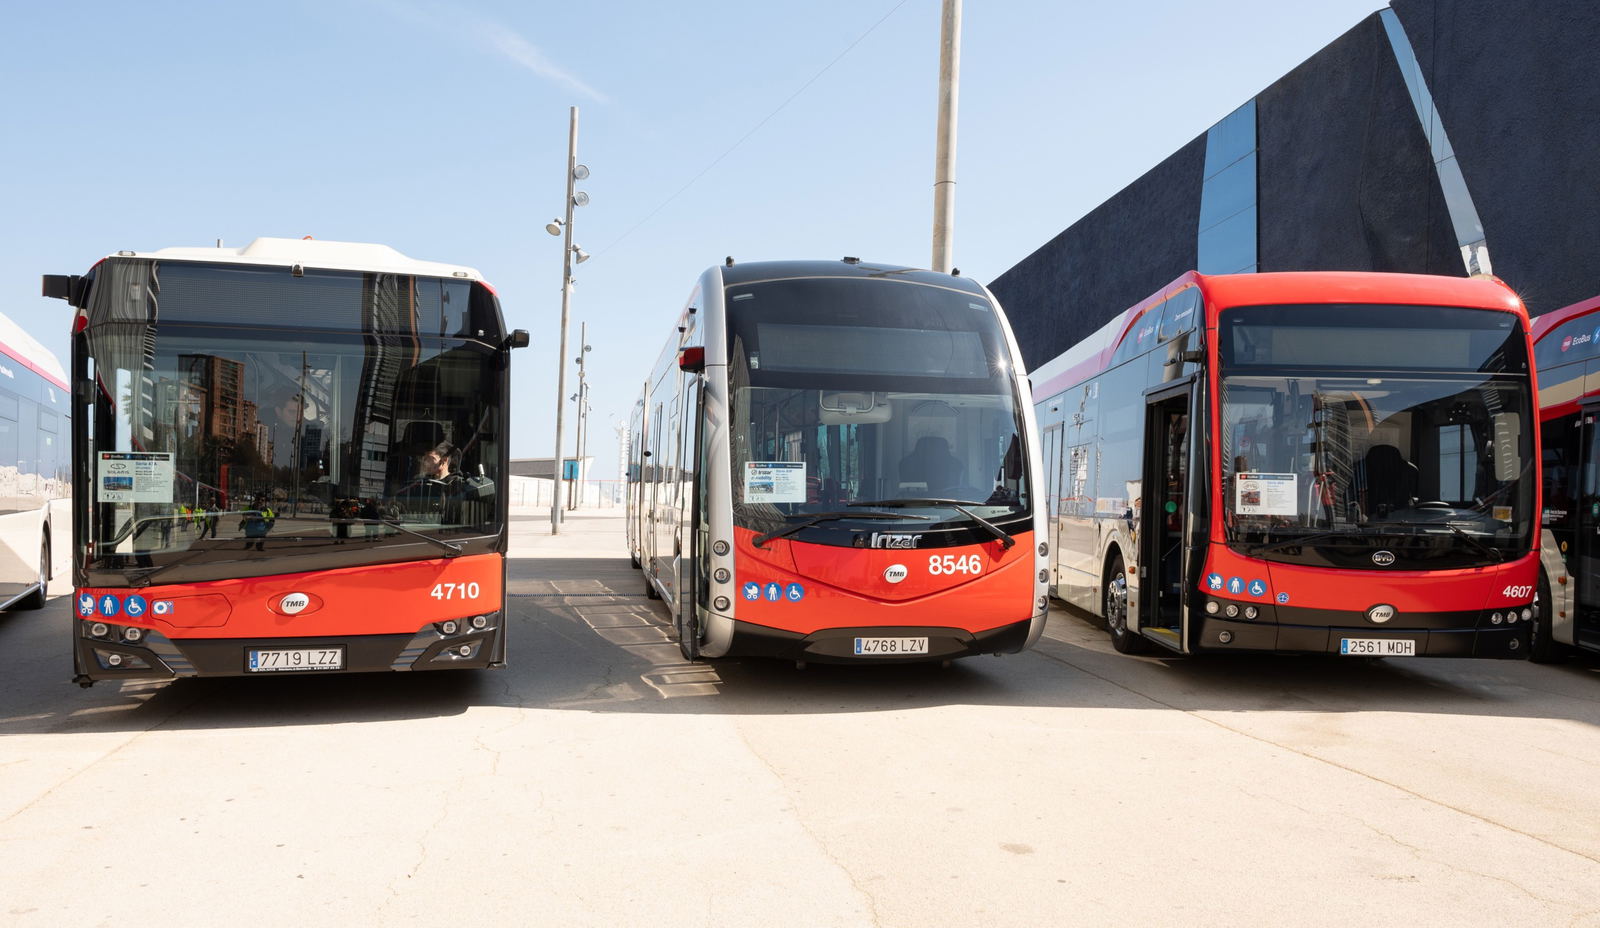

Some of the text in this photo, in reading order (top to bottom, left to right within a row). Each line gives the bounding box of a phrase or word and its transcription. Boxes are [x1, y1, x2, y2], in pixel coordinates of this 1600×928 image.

[1571, 334, 1592, 346] EcoBus
[871, 532, 922, 549] Irizar
[928, 554, 982, 576] 8546
[1374, 554, 1393, 562] BYD
[430, 582, 480, 600] 4710
[1502, 585, 1533, 598] 4607
[285, 600, 305, 608] TMB
[864, 638, 925, 653] 4768 LZV
[1350, 640, 1412, 654] 2561 MDH
[260, 652, 302, 667] 7719
[307, 650, 338, 666] LZZ
